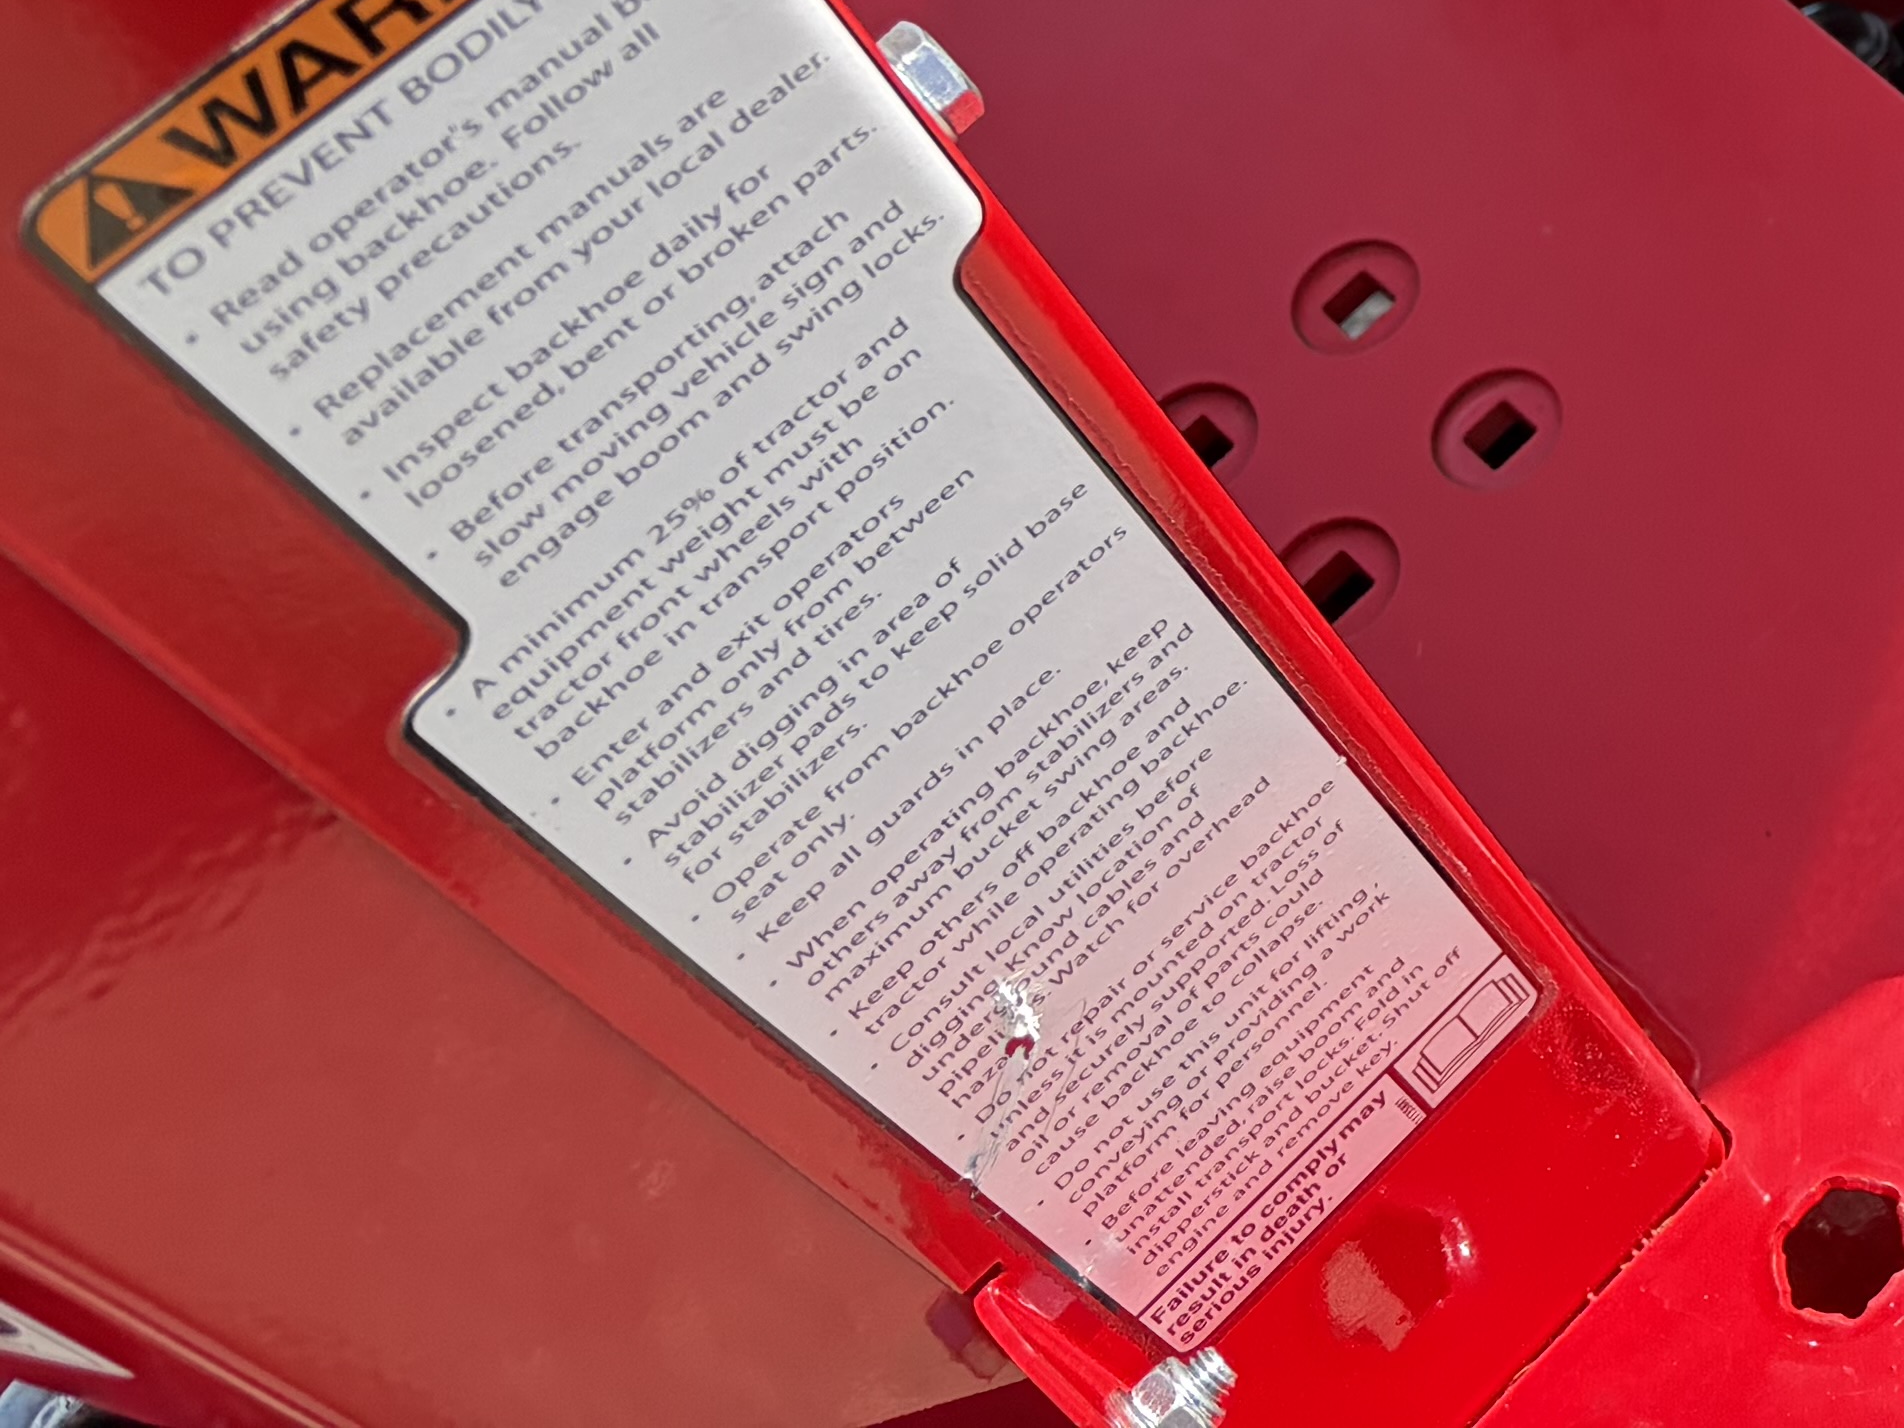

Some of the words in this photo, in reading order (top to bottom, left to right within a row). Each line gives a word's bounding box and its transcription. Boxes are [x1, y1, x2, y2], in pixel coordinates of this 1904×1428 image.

[138, 245, 207, 296] TO
[206, 97, 394, 250] PREVENT
[208, 248, 306, 328] Read
[307, 118, 484, 254] operator's
[483, 12, 614, 120] manual
[239, 275, 342, 355] using
[334, 159, 500, 278] backhoe.
[499, 58, 615, 152] Follow
[619, 21, 661, 63] all
[268, 295, 371, 381] safety
[374, 140, 582, 303] precautions.
[312, 243, 536, 420] Replacement
[534, 133, 674, 246] manuals
[676, 89, 728, 135] are
[342, 327, 486, 447] available
[485, 260, 571, 327] from
[570, 196, 645, 266] your
[644, 129, 726, 199] local
[728, 51, 831, 135] dealer.
[381, 382, 508, 484] Inspect
[503, 269, 646, 384] backhoe
[648, 202, 722, 269] daily
[724, 164, 771, 206] for
[403, 380, 566, 509] loosened,
[558, 316, 641, 382] bent
[642, 282, 676, 317] or
[675, 193, 791, 285] broken
[791, 126, 878, 197] parts.
[448, 455, 555, 544] Before
[556, 294, 757, 454] transporting,
[756, 211, 850, 292] attach
[471, 677, 499, 701] A
[498, 547, 646, 675] minimum
[646, 488, 716, 546] 25%
[718, 450, 750, 486] of
[751, 368, 849, 455] tractor
[854, 315, 910, 371] and
[474, 502, 546, 568] slow
[549, 401, 672, 504] moving
[669, 310, 779, 399] vehicle
[780, 255, 845, 311] sign
[847, 198, 905, 255] and
[491, 577, 658, 721] equipment
[656, 485, 763, 574] weight
[762, 419, 840, 486] must
[836, 384, 880, 420] be
[882, 348, 923, 383] on
[498, 489, 615, 588] engage
[612, 409, 711, 489] boom
[713, 351, 773, 408] and
[774, 278, 865, 356] swing
[860, 214, 945, 280] locks.
[513, 650, 612, 740] tractor
[614, 584, 693, 651] front
[692, 495, 796, 583] wheels
[796, 436, 864, 492] with
[533, 648, 664, 761] backhoe
[662, 619, 698, 648] in
[698, 500, 834, 617] transport
[833, 399, 955, 504] position.
[570, 716, 650, 788] Enter
[655, 661, 713, 717] and
[715, 613, 771, 663] exit
[772, 494, 905, 613] operators
[593, 698, 718, 811] platform
[720, 637, 780, 696] only
[783, 577, 854, 638] from
[851, 469, 976, 576] between
[614, 701, 755, 826] stabilizers
[757, 645, 813, 701] and
[812, 592, 883, 647] tires.
[647, 771, 728, 850] Avoid
[730, 674, 840, 772] digging
[836, 647, 870, 674] in
[872, 591, 932, 646] area
[934, 555, 962, 589] of
[663, 753, 785, 868] stabilizer
[789, 692, 858, 757] pads
[857, 662, 890, 691] to
[889, 600, 959, 662] keep
[962, 536, 1025, 600] solid
[1023, 483, 1089, 540] base
[711, 804, 823, 904] Operate
[823, 743, 891, 803] from
[889, 638, 1005, 742] backhoe
[1007, 525, 1128, 637] operators
[681, 845, 722, 885] for
[727, 722, 869, 846] stabilizers.
[730, 870, 789, 925] seat
[790, 812, 856, 869] only.
[755, 880, 827, 944] Keep
[829, 844, 863, 879] all
[865, 761, 955, 847] guards
[954, 735, 985, 761] in
[986, 668, 1062, 736] place.
[785, 899, 867, 969] When
[869, 780, 995, 897] operating
[993, 678, 1109, 780] backhoe,
[1105, 618, 1169, 676] keep
[807, 909, 890, 987] others
[891, 843, 956, 909] away
[959, 786, 1023, 844] from
[1025, 671, 1145, 785] stabilizers
[1147, 621, 1195, 671] and
[824, 883, 953, 1003] maximum
[951, 798, 1043, 881] bucket
[1043, 727, 1118, 798] swing
[1118, 665, 1189, 728] areas.
[847, 959, 915, 1021] Keep
[918, 880, 999, 957] others
[1001, 839, 1036, 879] off
[1035, 745, 1142, 844] backhoe
[1144, 695, 1192, 745] and
[864, 955, 948, 1036] tractor
[951, 890, 1020, 953] while
[1023, 777, 1141, 888] operating
[1139, 680, 1249, 777] backhoe.
[1149, 1248, 1231, 1326] Failure
[1230, 1222, 1257, 1246] to
[1259, 1137, 1339, 1219] comply
[1337, 1089, 1387, 1141] may
[1166, 1271, 1233, 1337] result
[1230, 1246, 1258, 1270] in
[1259, 1181, 1322, 1244] death
[1324, 1152, 1347, 1179] or
[1179, 1263, 1262, 1346] serious
[1260, 1195, 1334, 1262] injury.
